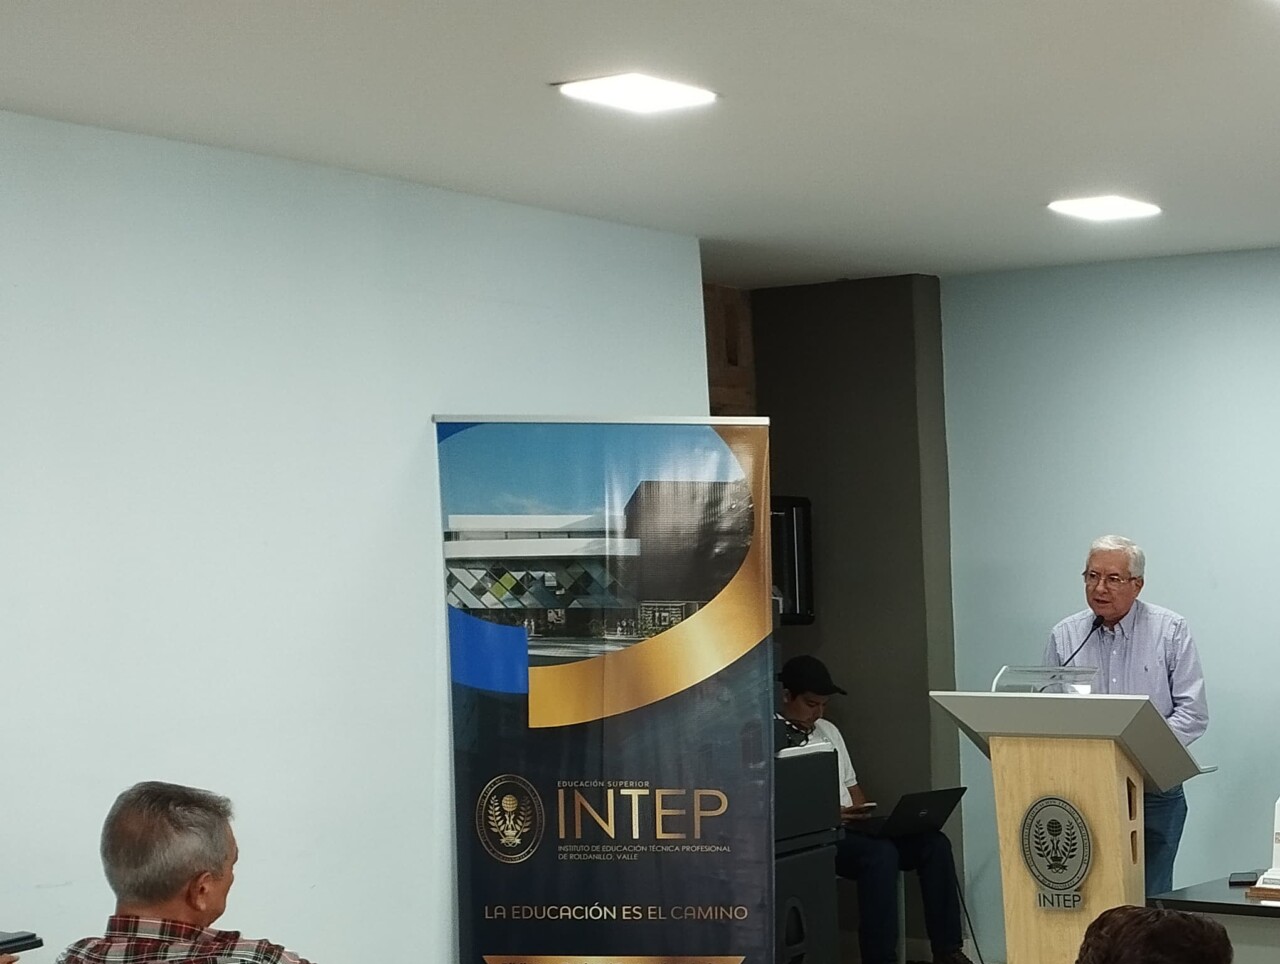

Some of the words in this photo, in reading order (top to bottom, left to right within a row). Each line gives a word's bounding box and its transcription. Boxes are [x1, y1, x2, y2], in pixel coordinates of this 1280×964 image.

[557, 780, 604, 788] EDUCACIÓN
[557, 788, 729, 840] INTEP
[601, 844, 648, 852] EDUCACIÓN
[649, 844, 681, 852] TÉCNICA
[1038, 893, 1081, 908] INTEP
[484, 905, 506, 919] LA
[511, 902, 617, 920] EDUCACIÓN
[622, 906, 642, 920] ES
[647, 906, 667, 920] EL
[671, 906, 748, 920] CAMINO
